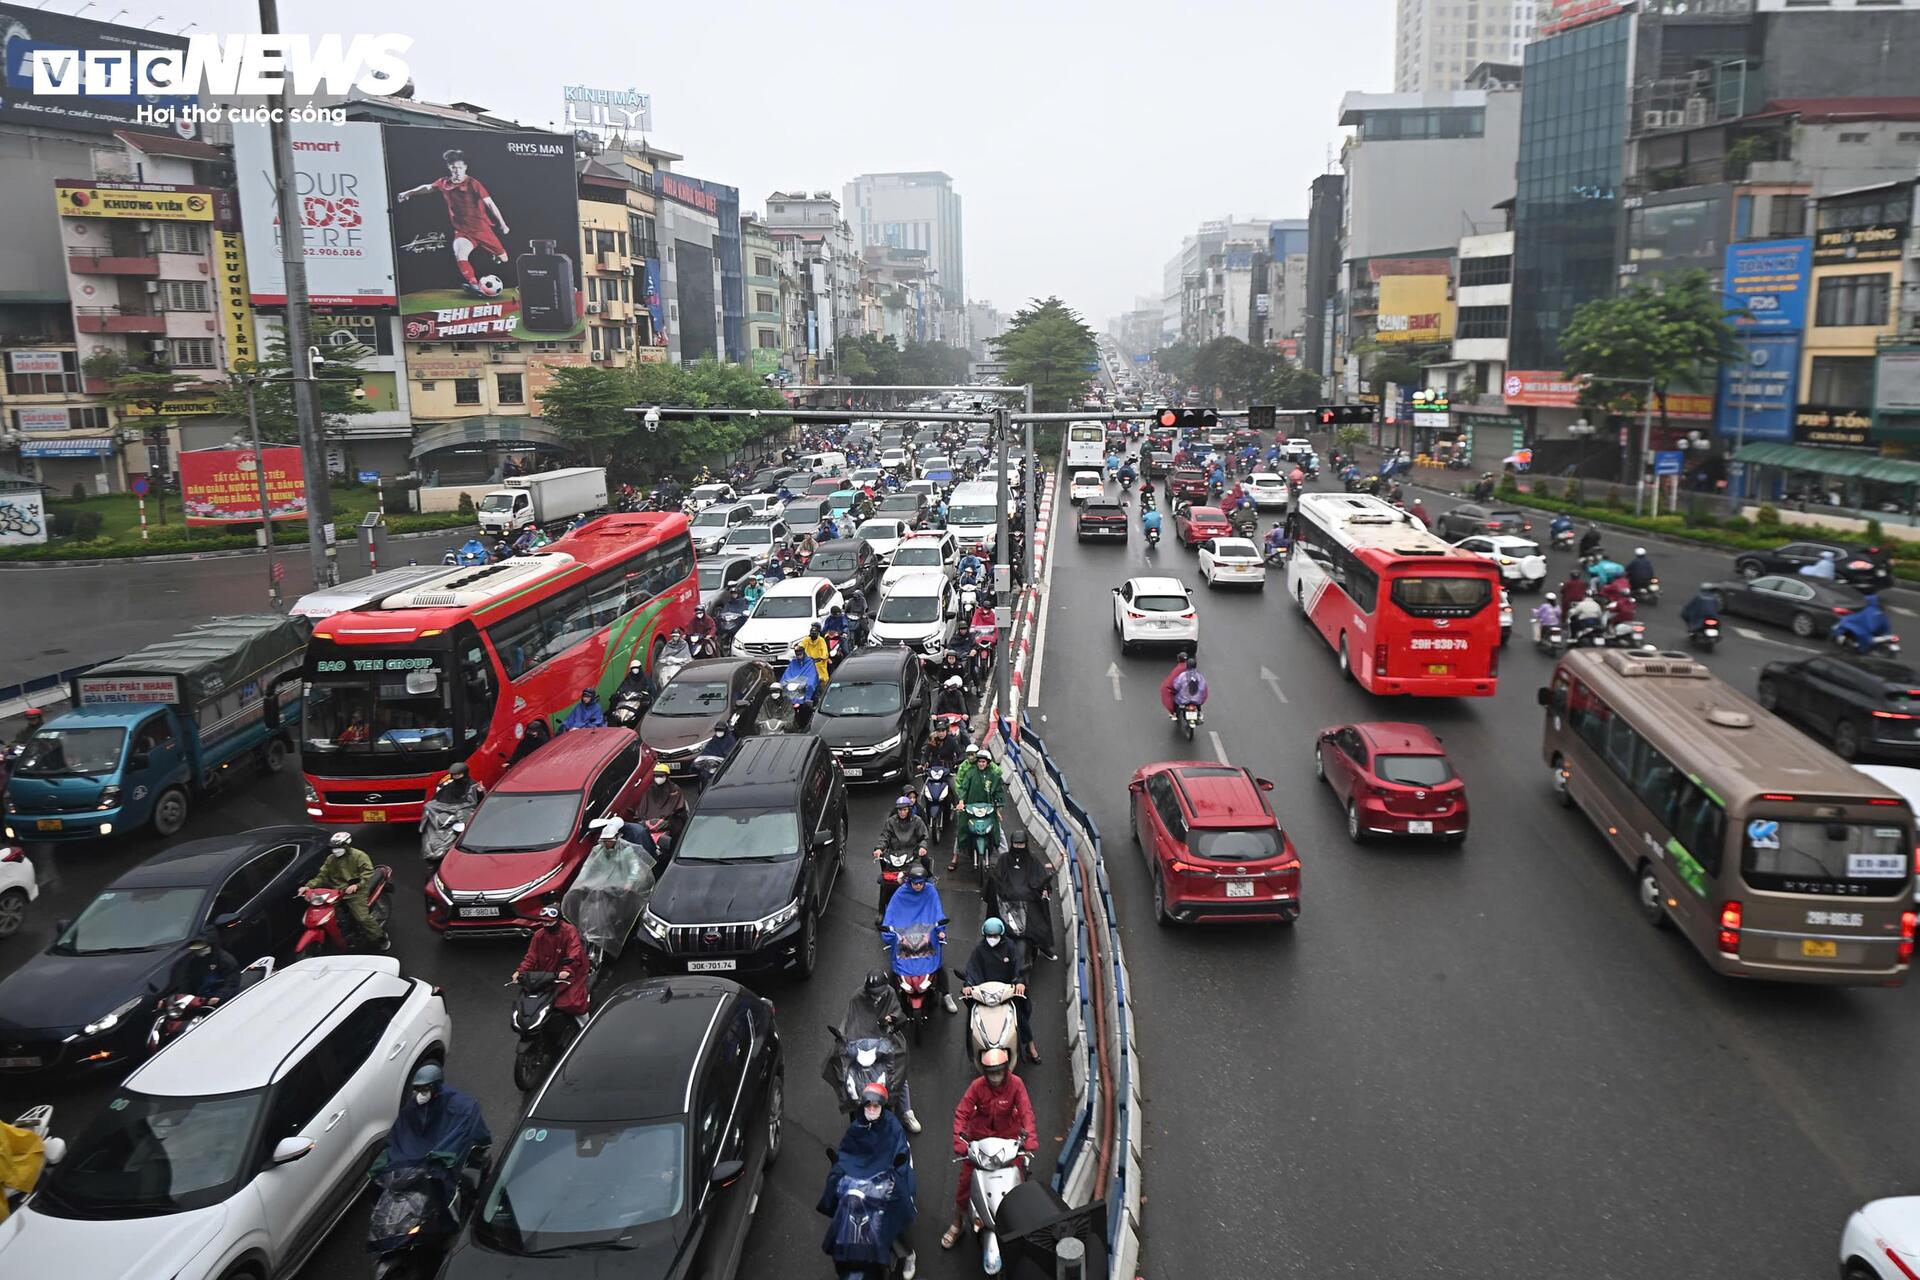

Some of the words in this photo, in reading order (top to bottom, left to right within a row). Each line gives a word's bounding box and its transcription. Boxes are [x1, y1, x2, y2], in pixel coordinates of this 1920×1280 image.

[564, 84, 610, 104] KÍNH
[508, 142, 537, 153] RHYS
[539, 145, 564, 155] MAN
[223, 239, 244, 307] KHƯƠNG
[232, 312, 249, 355] VIÊN
[1833, 410, 1872, 428] TỐN
[251, 482, 276, 491] MNH,
[318, 661, 346, 671] BAO
[353, 660, 384, 670] YEN
[386, 658, 433, 669] GROUP
[691, 961, 733, 970] 30K-701.74
